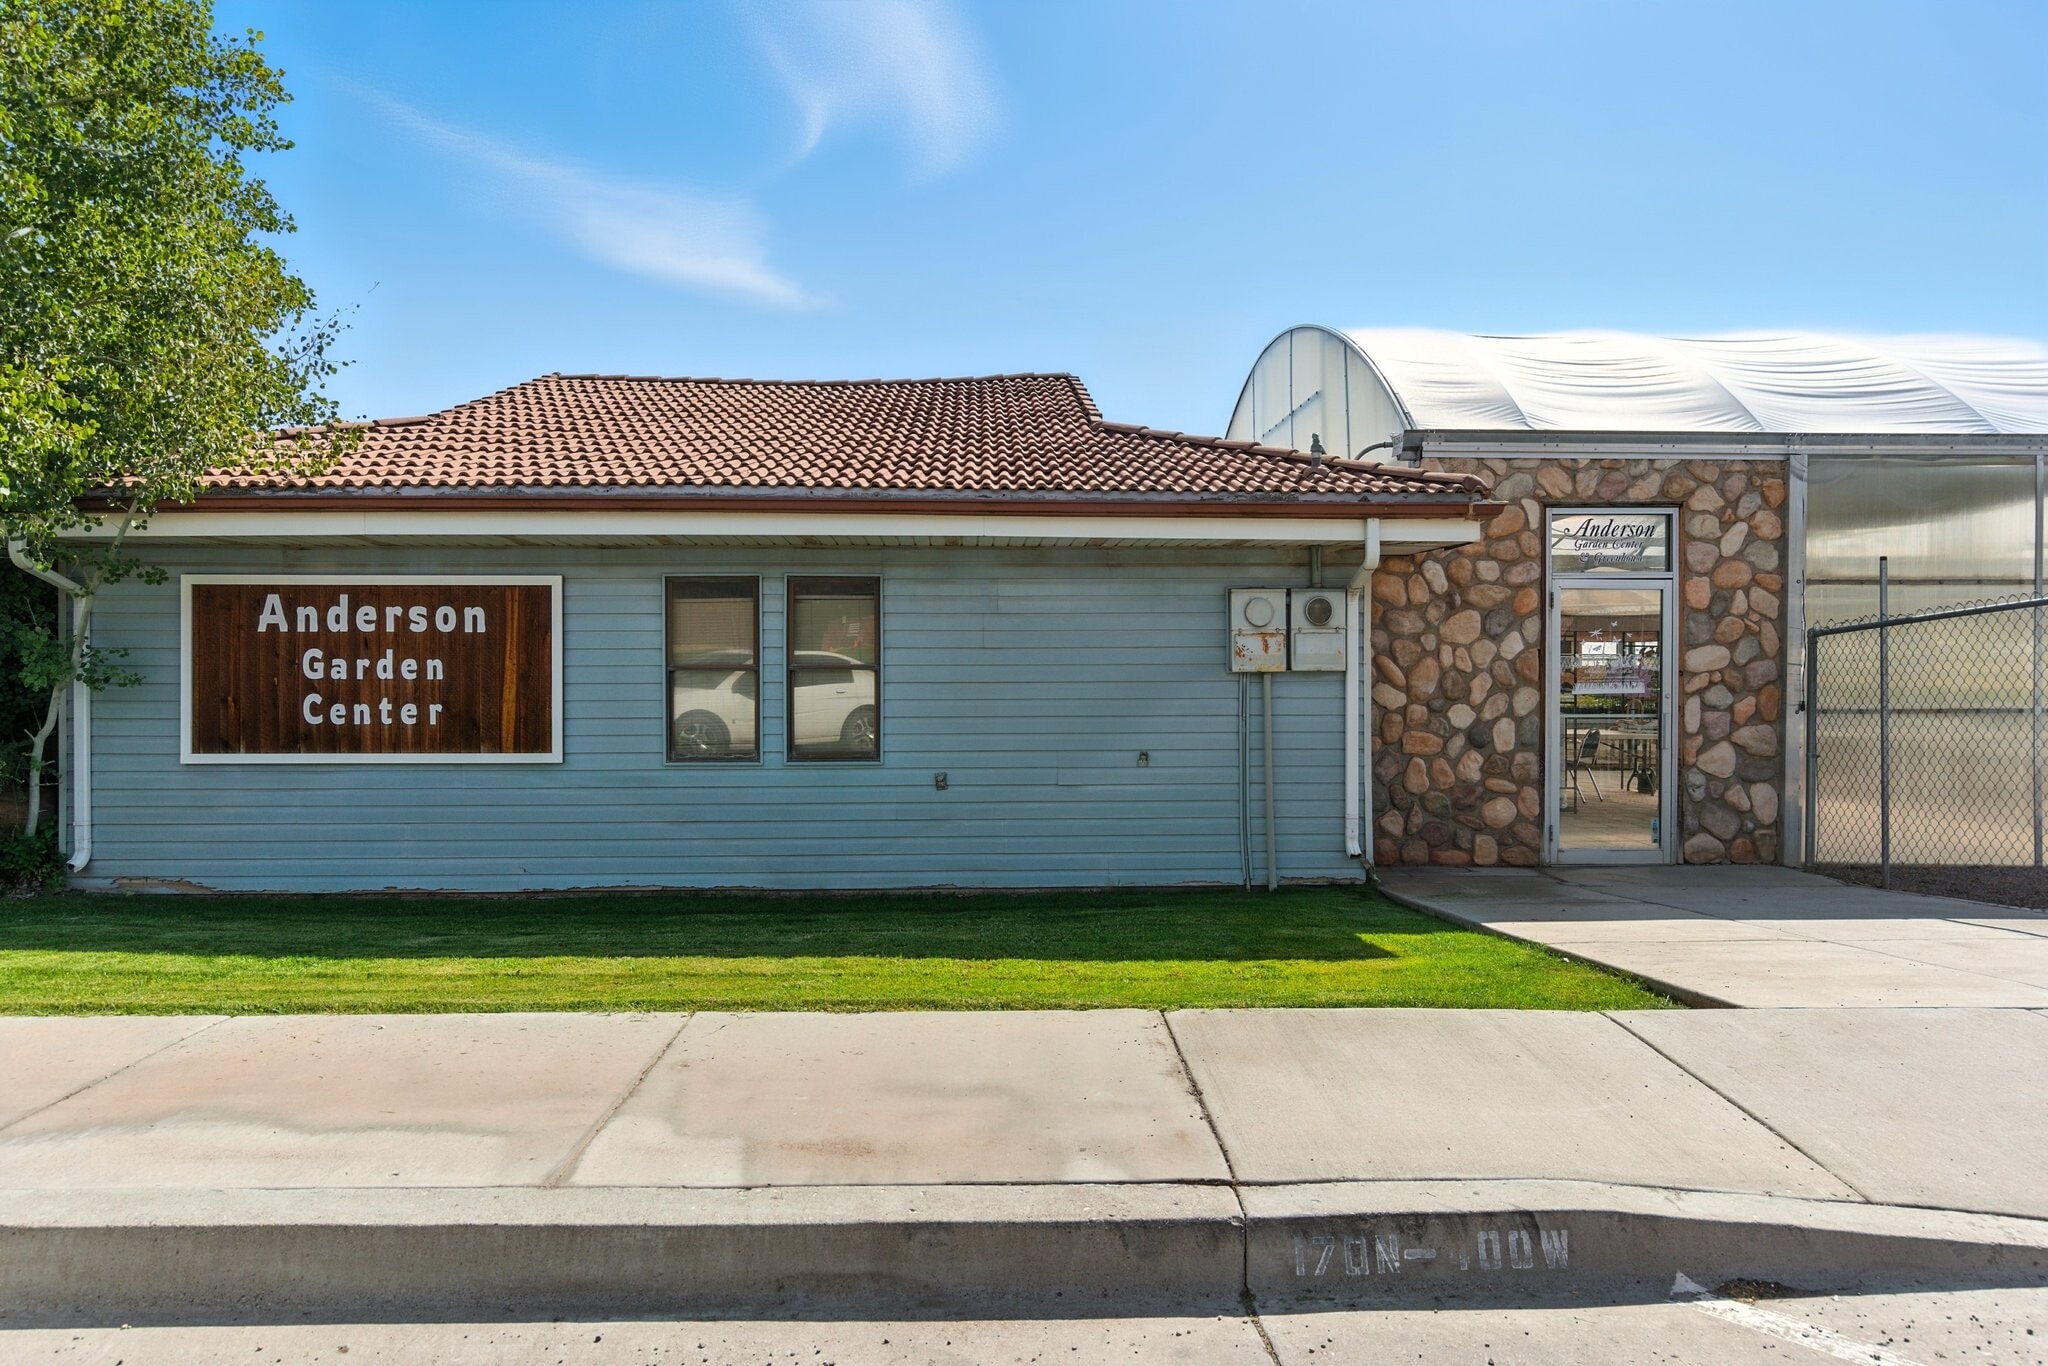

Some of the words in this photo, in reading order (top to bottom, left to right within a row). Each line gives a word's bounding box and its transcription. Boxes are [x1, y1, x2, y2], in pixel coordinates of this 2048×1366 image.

[1564, 518, 1656, 538] Anderson
[1574, 539, 1608, 551] Garden
[1612, 539, 1643, 549] Center
[1579, 552, 1590, 562] &
[257, 593, 486, 633] Anderson
[302, 648, 444, 680] Garden
[302, 693, 443, 725] Center
